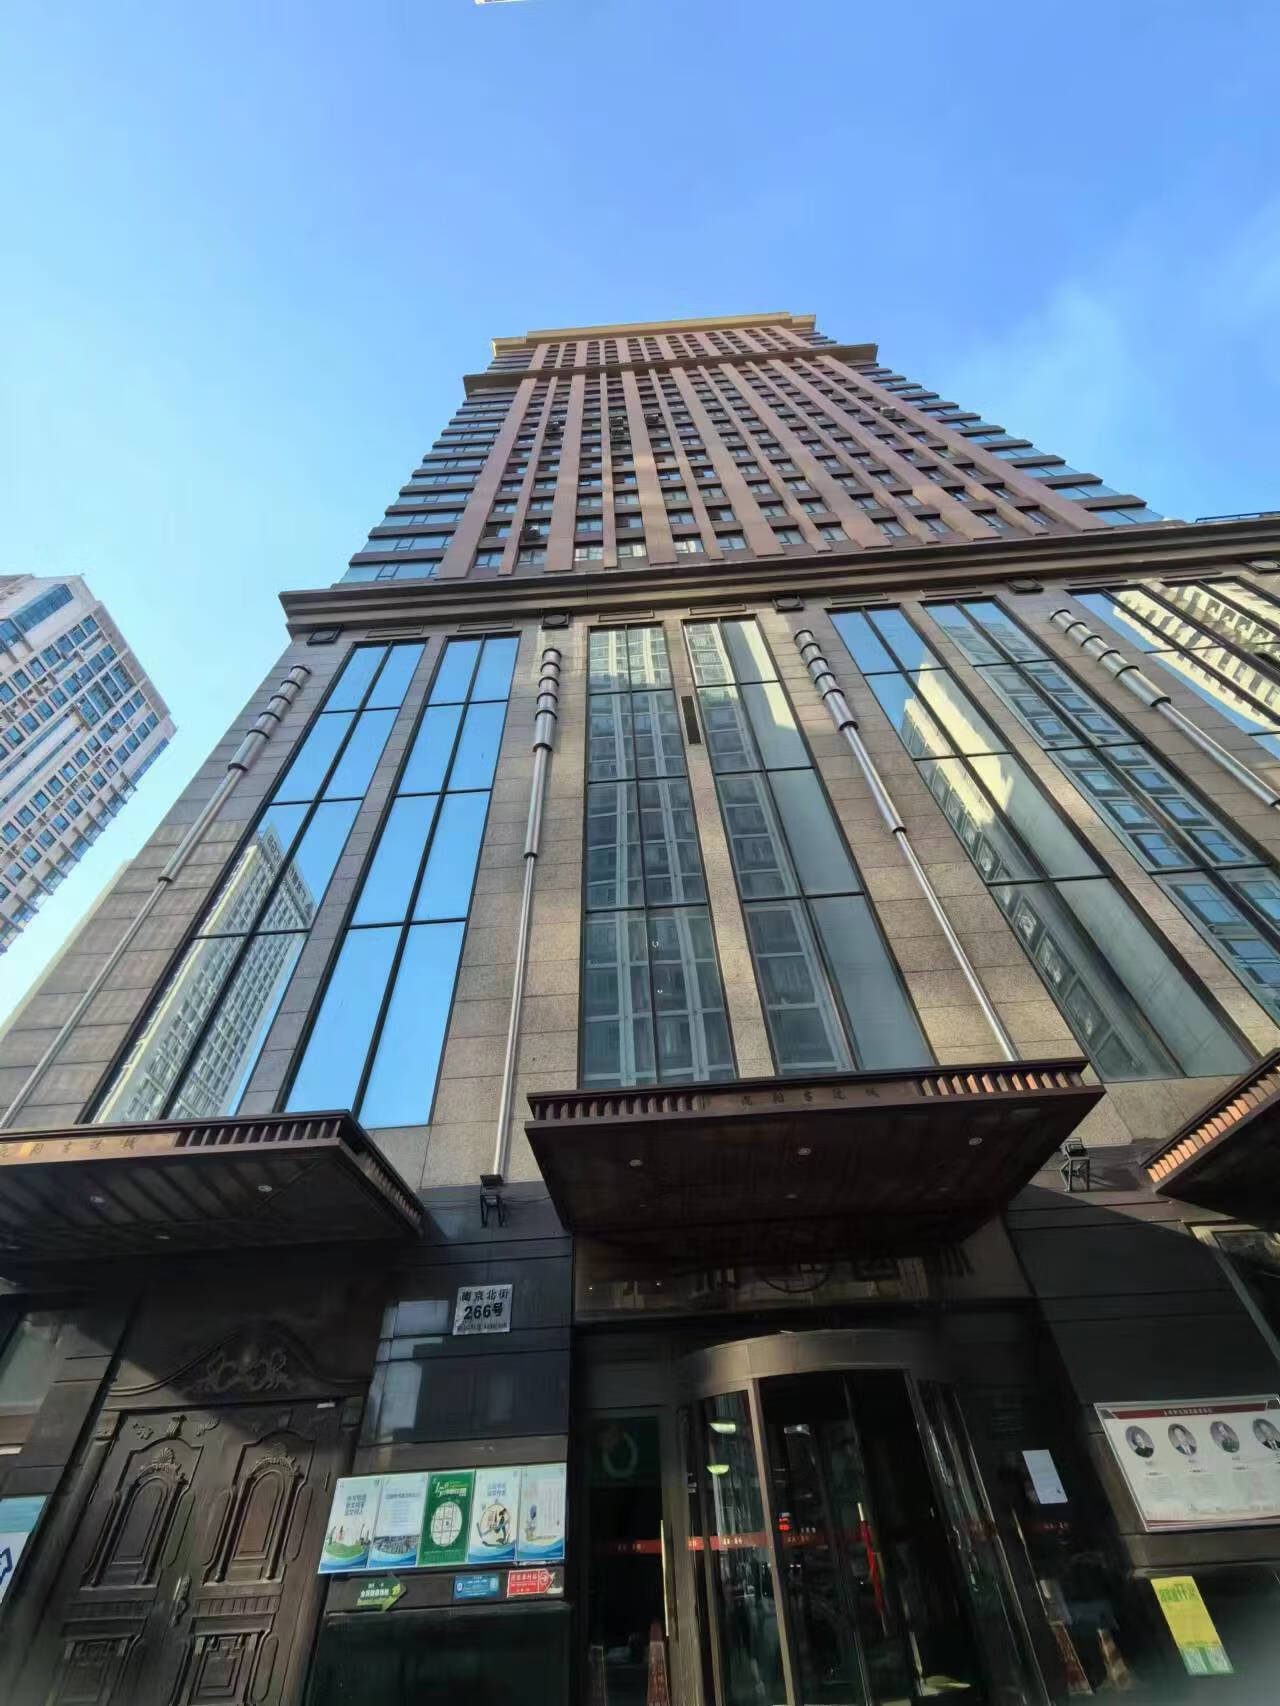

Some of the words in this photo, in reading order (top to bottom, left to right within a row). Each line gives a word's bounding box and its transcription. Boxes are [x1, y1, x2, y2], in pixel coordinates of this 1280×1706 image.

[462, 1288, 509, 1301] 南京北街
[464, 1302, 503, 1320] 266号
